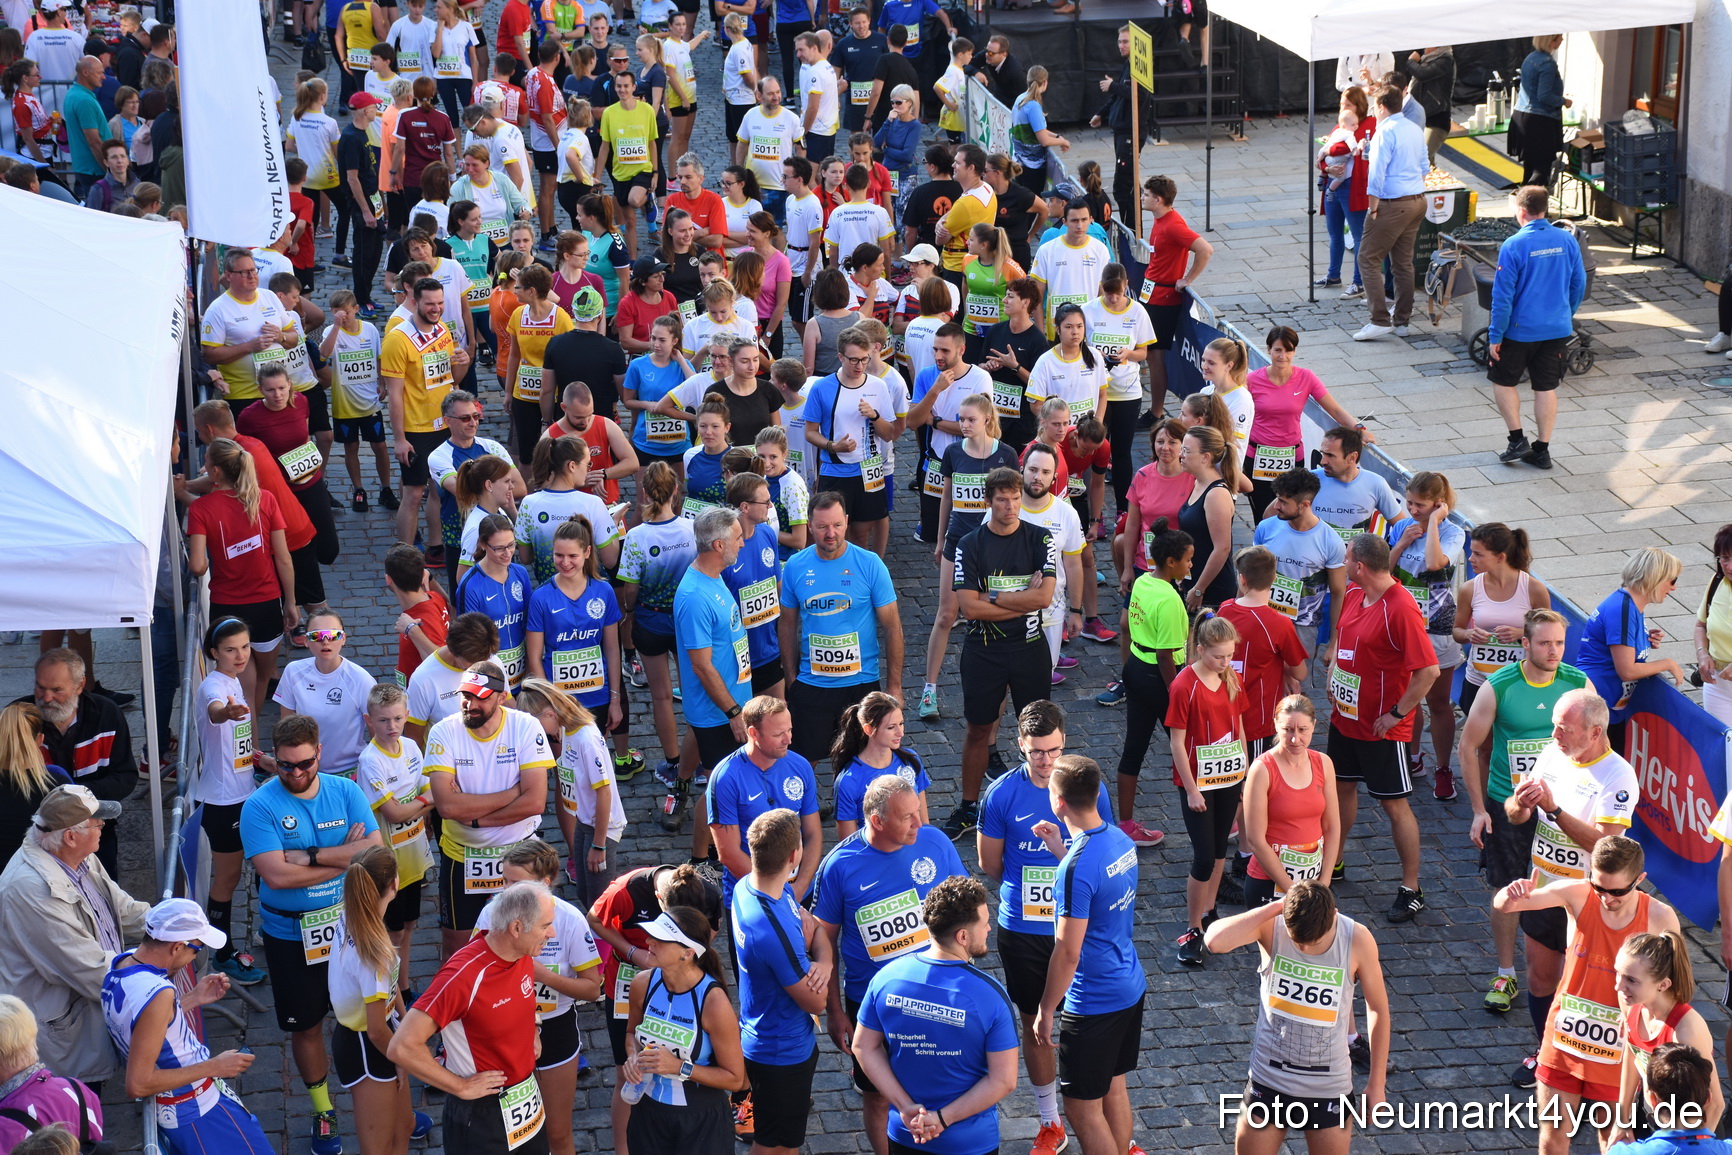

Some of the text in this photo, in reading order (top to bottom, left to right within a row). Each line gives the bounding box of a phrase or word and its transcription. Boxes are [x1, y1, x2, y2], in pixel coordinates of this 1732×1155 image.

[1134, 37, 1147, 57] FUN
[350, 55, 368, 63] 5173
[399, 59, 418, 67] 5268
[439, 62, 457, 70] 5267
[1134, 56, 1148, 78] RUN
[620, 147, 644, 155] 5046
[755, 145, 777, 154] 5011
[257, 85, 283, 243] PARTL NEUMARKT
[1053, 295, 1088, 304] BOCK
[681, 304, 695, 312] BO
[969, 305, 995, 316] 5257
[535, 328, 555, 336] BÖGL
[1092, 334, 1130, 344] BOCK
[256, 349, 286, 360] BOCK
[340, 350, 373, 360] BOCK
[424, 350, 448, 364] BOCK
[344, 361, 373, 373] 4015
[428, 359, 449, 375] 5101
[521, 367, 542, 375] BOC
[522, 377, 542, 388] 509
[1068, 399, 1094, 412] OCK
[651, 421, 683, 433] 5226
[284, 446, 314, 466] BOCK
[1259, 447, 1294, 456] BOCK
[290, 456, 319, 477] 5026
[864, 457, 884, 467] BOC
[1259, 458, 1291, 469] 5229
[867, 467, 884, 479] 505
[928, 472, 944, 485] 505
[237, 542, 252, 552] DEHN
[662, 541, 690, 552] Bionorica
[741, 582, 774, 598] BOCK
[993, 579, 1031, 588] BOCK
[1269, 587, 1294, 605] 134
[746, 597, 775, 614] 5075
[750, 611, 775, 624] MICHAEL
[556, 628, 600, 643] #LÄUFT
[813, 635, 855, 646] BOCK
[498, 645, 525, 662] BOC
[557, 648, 599, 664] BOCK
[814, 649, 855, 663] 5094
[1476, 647, 1517, 663] 5284
[559, 663, 599, 681] 5072
[820, 664, 851, 672] LOTHAR
[563, 680, 596, 690] SANDRA
[1331, 681, 1353, 704] 5185
[429, 742, 445, 755] 20
[1201, 743, 1241, 758] BOCK
[1513, 742, 1546, 752] BOC
[242, 758, 253, 766] SAN
[1203, 757, 1242, 775] 5183
[1516, 757, 1536, 772] 57
[1205, 775, 1238, 785] KATHRIN
[1630, 717, 1716, 845] Hervis
[317, 819, 346, 829] BOCK
[407, 828, 419, 838] LUIS
[468, 847, 504, 858] BOC
[1537, 840, 1579, 866] 5269
[472, 861, 504, 876] 510
[1028, 870, 1057, 880] BO
[308, 888, 336, 898] Stadtlauf
[1030, 886, 1054, 903] 50
[306, 905, 344, 923] BOC
[859, 896, 912, 923] BOCK
[1040, 907, 1054, 915] KE
[867, 911, 919, 943] 5080
[882, 936, 916, 953] HORST
[1278, 961, 1336, 985] BOCK
[1277, 979, 1334, 1007] 5266
[1565, 997, 1621, 1022] BOCK
[1562, 1016, 1618, 1046] 5000
[901, 1041, 918, 1049] Immer
[1561, 1035, 1615, 1057] CHRISTOPH
